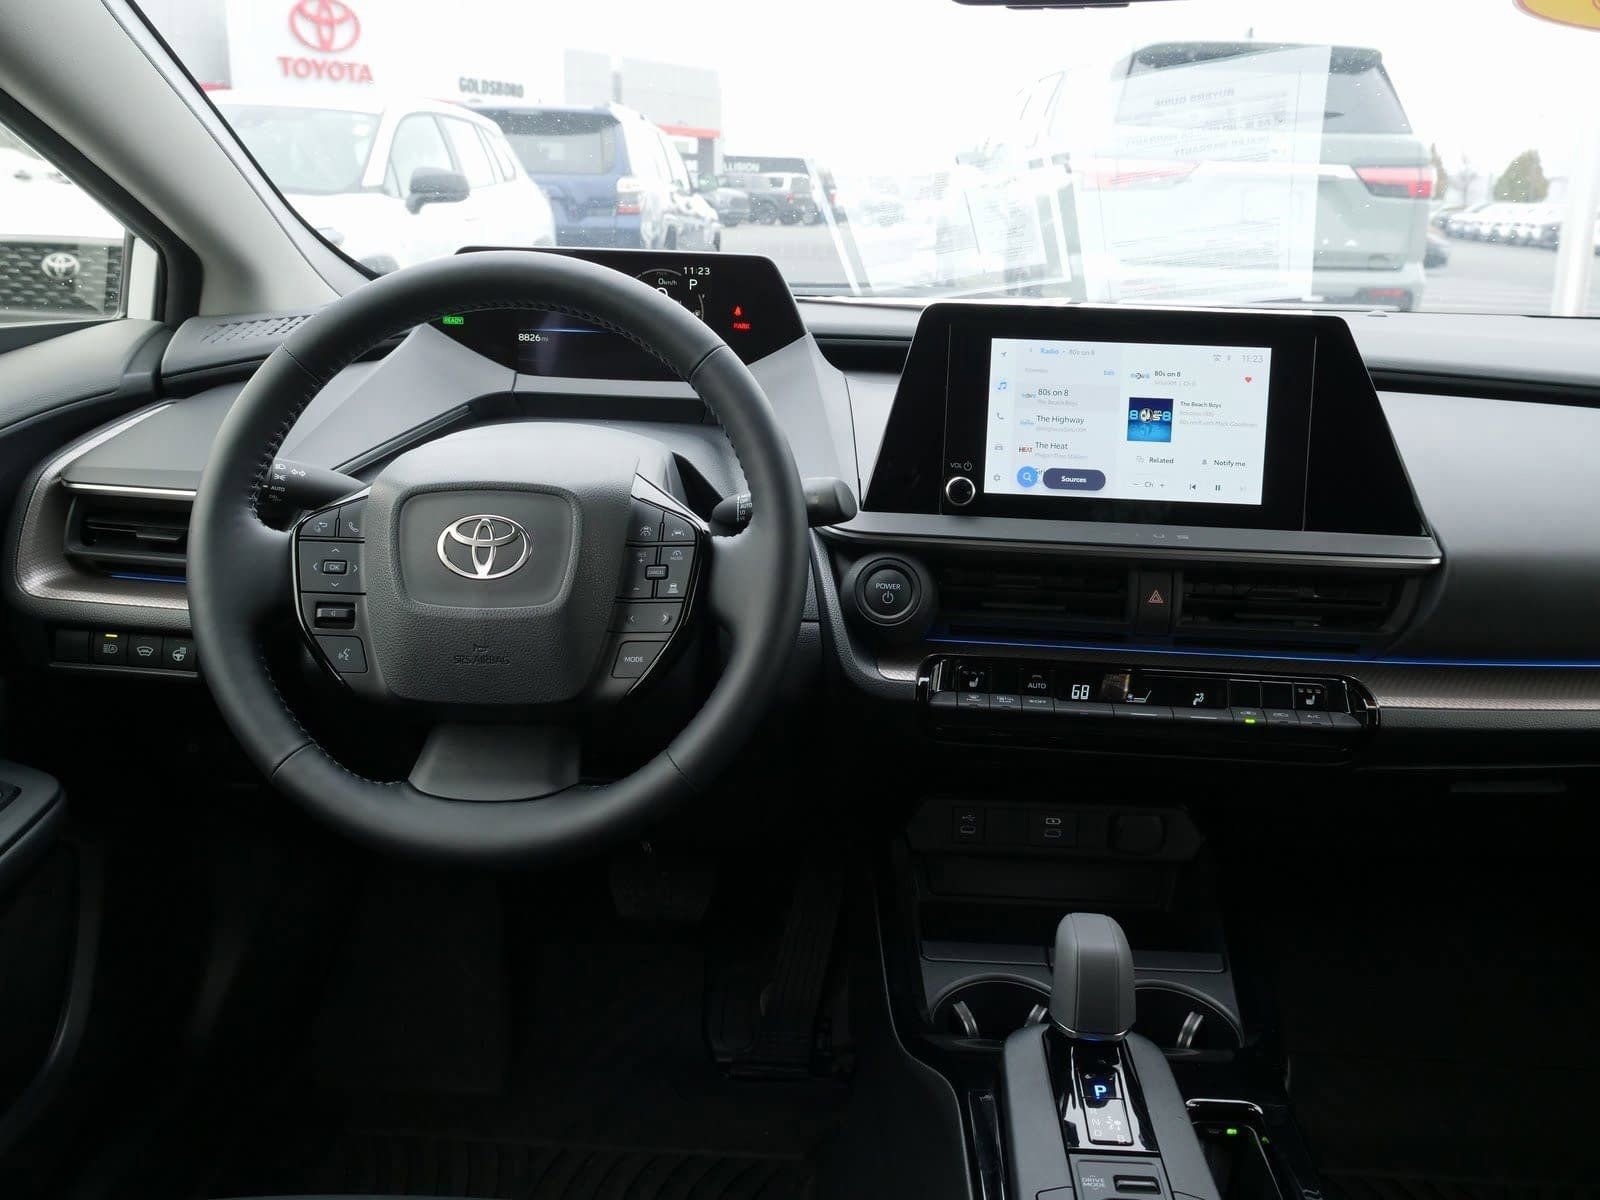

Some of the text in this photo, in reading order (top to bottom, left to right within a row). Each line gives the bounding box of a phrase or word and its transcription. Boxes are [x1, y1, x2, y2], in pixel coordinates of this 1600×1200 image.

[277, 56, 374, 84] TOYOTA
[458, 76, 525, 99] GOLDSBORO
[683, 266, 711, 276] 11:23
[689, 278, 698, 290] P
[518, 333, 541, 342] 8826
[1040, 347, 1060, 355] Radio
[1241, 354, 1264, 364] 11:23
[1038, 388, 1052, 397] 80s
[1063, 389, 1069, 397] 8
[1036, 415, 1050, 424] The
[1051, 415, 1085, 426] Highway
[1035, 441, 1069, 450] The Heat
[1149, 456, 1175, 464] Related
[1213, 459, 1235, 468] Notify
[1061, 475, 1088, 484] Sources
[328, 563, 341, 571] OK
[875, 582, 901, 590] POWER
[624, 655, 644, 664] MODE
[1027, 681, 1047, 690] AUTO
[1071, 683, 1091, 701] 68
[1093, 1084, 1107, 1098] P
